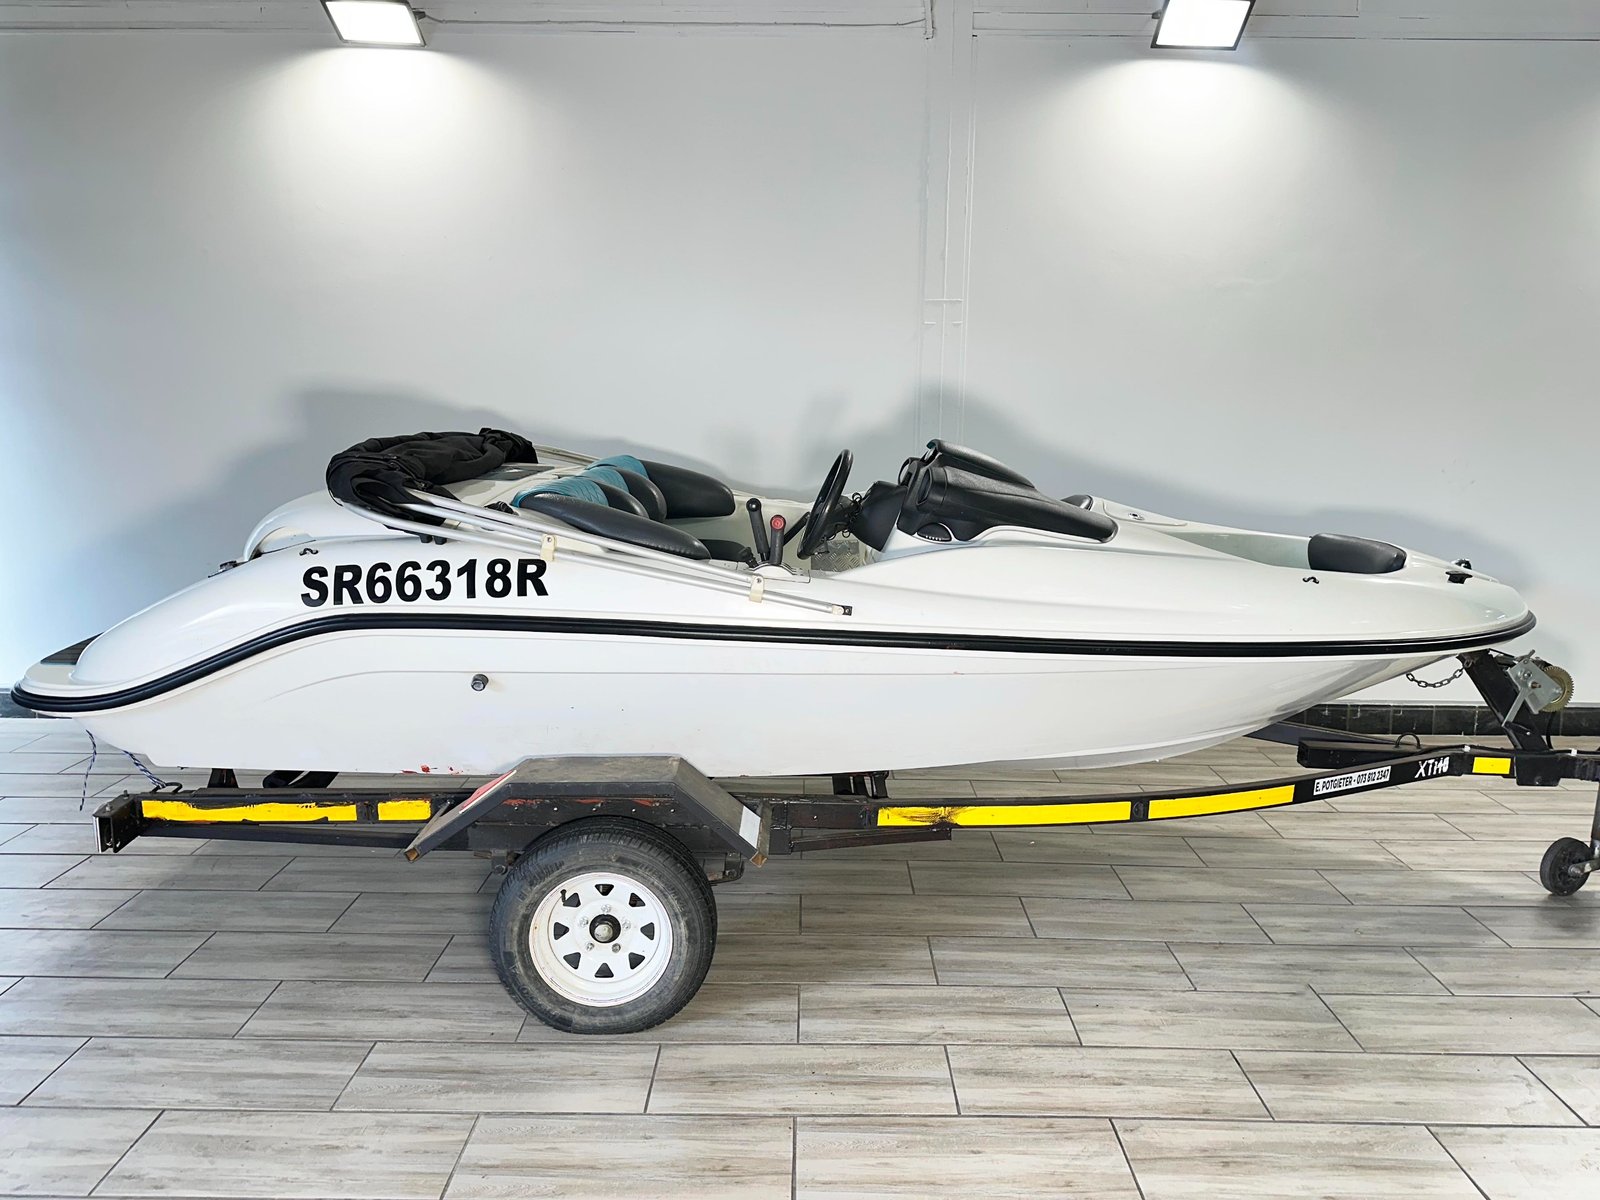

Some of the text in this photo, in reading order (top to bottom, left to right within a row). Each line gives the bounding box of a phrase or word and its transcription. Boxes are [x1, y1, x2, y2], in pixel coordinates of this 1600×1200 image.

[301, 558, 549, 607] SR66318R
[1315, 781, 1321, 793] E.
[1322, 776, 1353, 791] POTGIETER
[1356, 773, 1367, 784] 073
